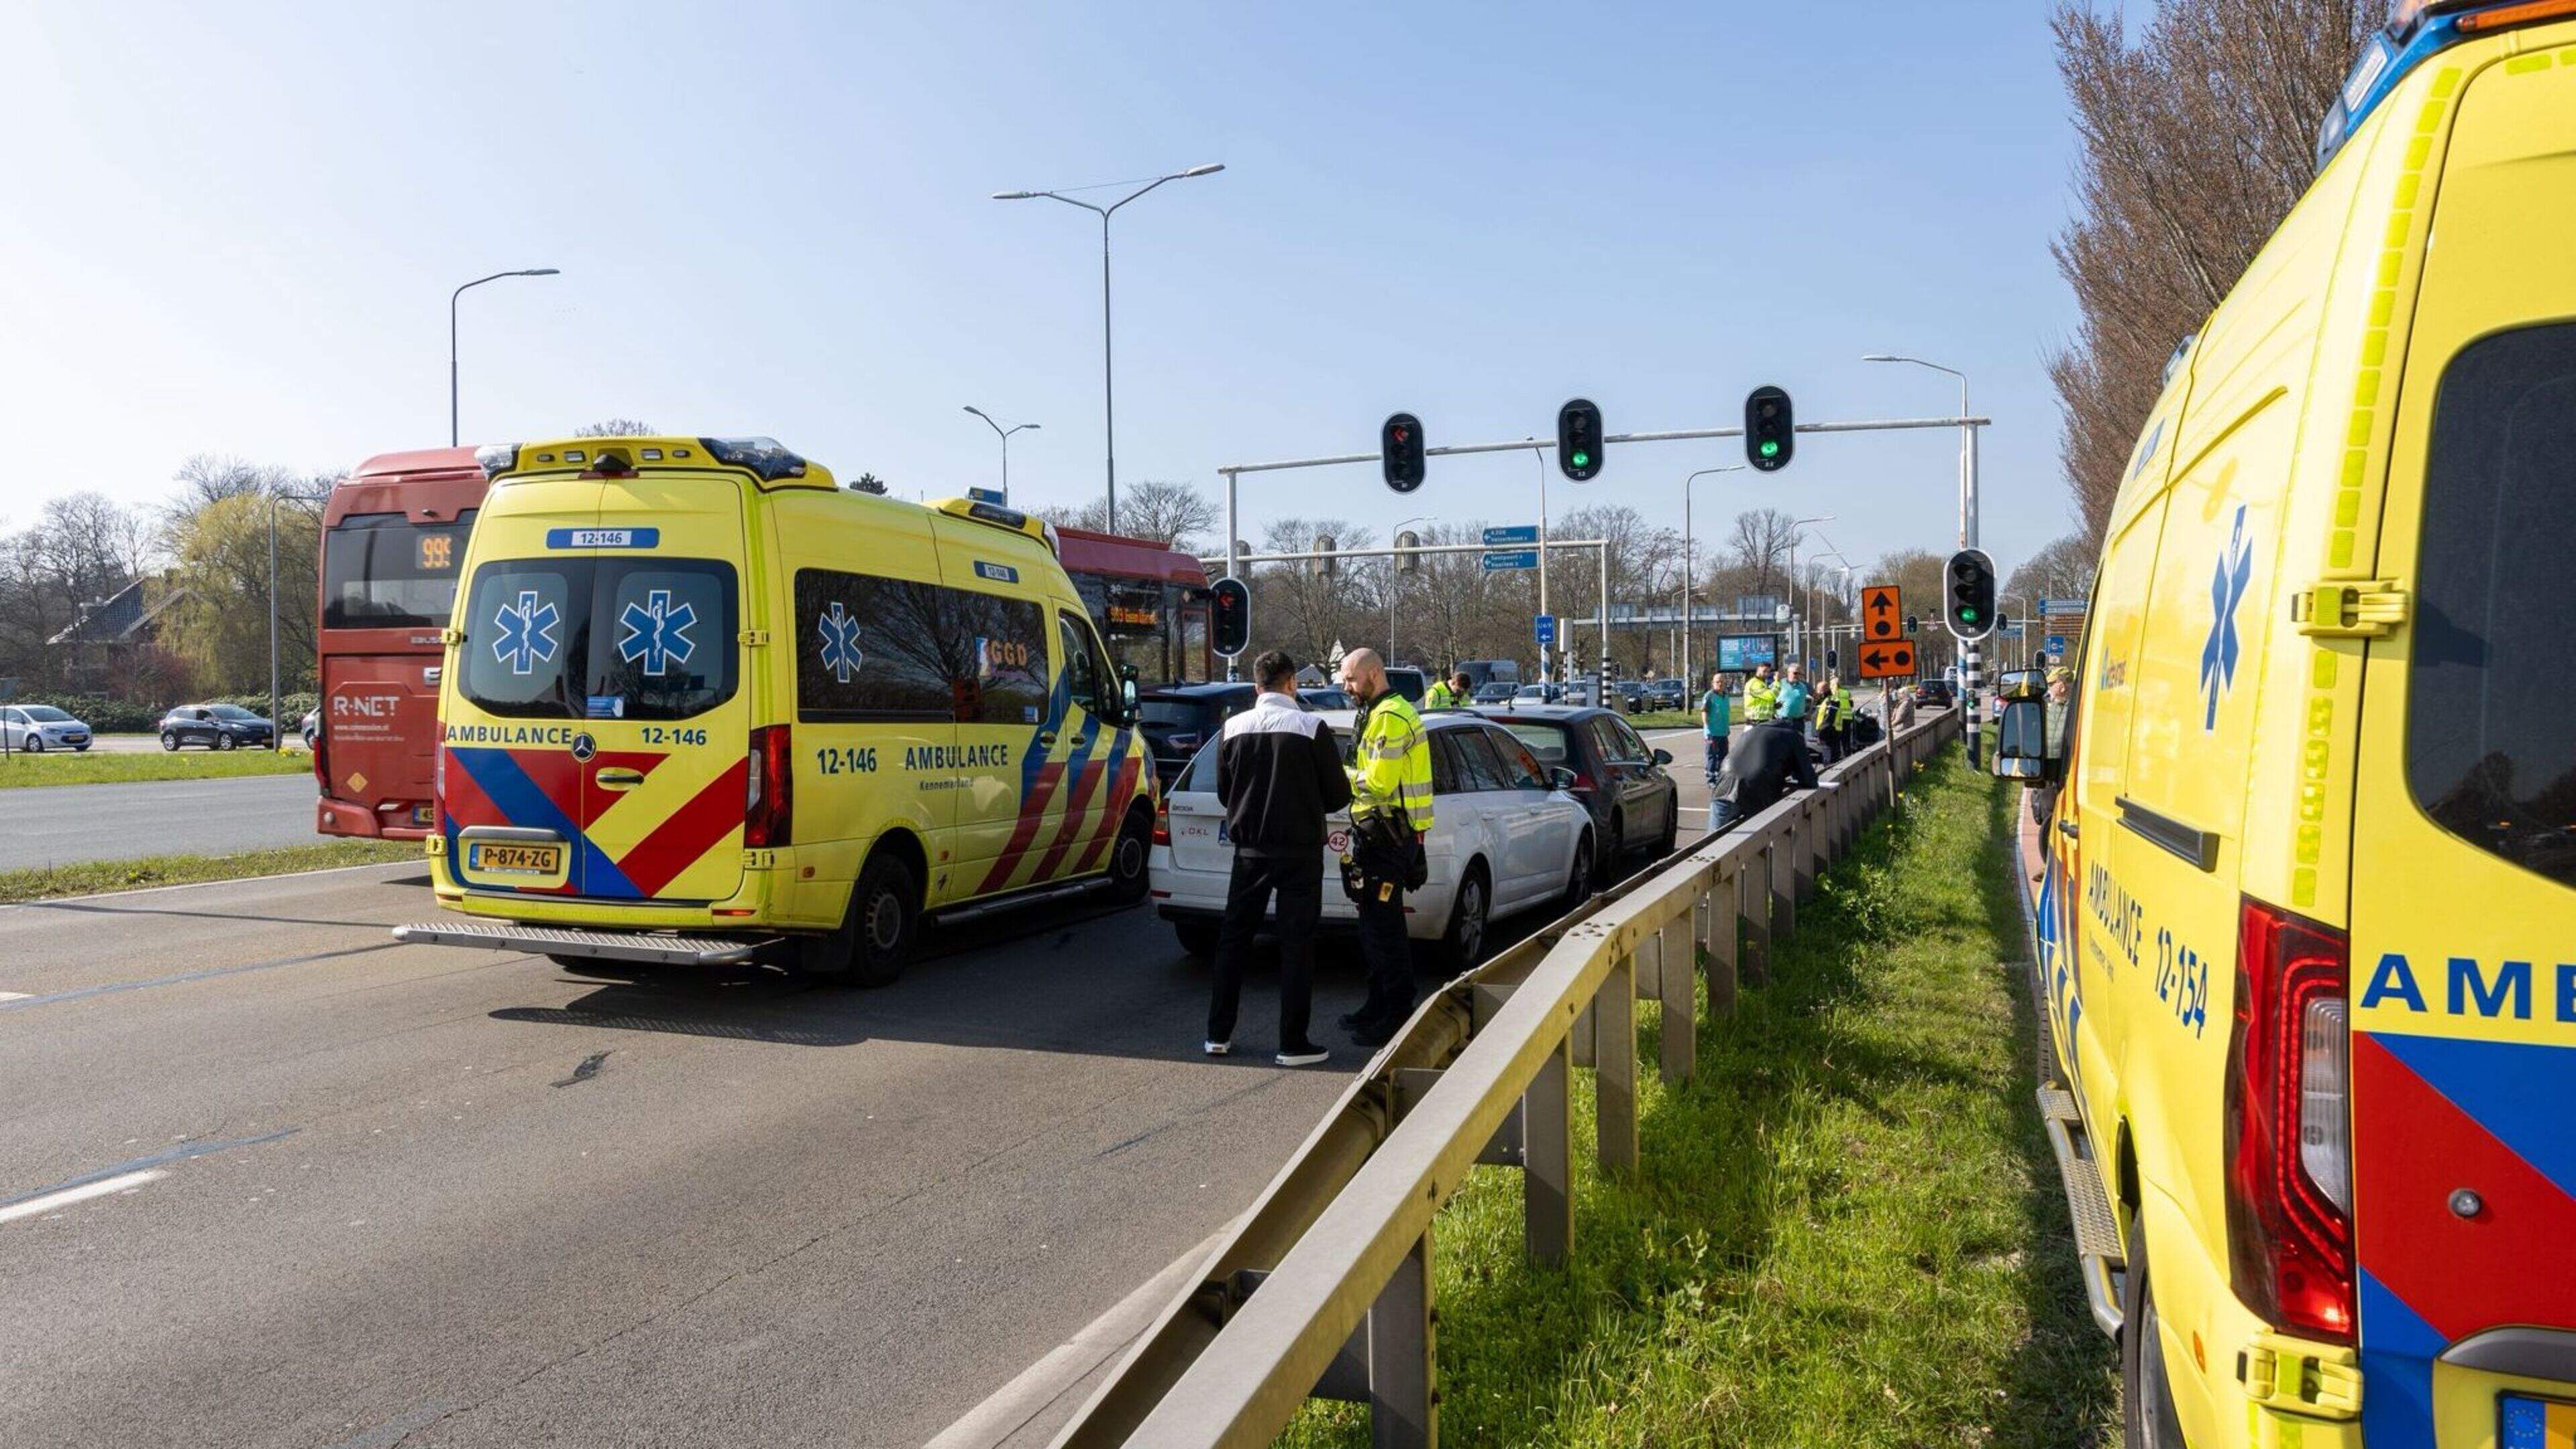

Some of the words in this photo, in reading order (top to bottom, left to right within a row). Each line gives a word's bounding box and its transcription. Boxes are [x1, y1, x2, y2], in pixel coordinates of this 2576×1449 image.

[581, 533, 623, 544] 12-146
[446, 725, 572, 744] AMBULANCE
[641, 728, 707, 745] 12-146
[816, 747, 877, 774] 12-146
[906, 745, 1008, 770] AMBULANCE
[1330, 837, 1346, 847] 42
[484, 847, 551, 867] P-874-ZG
[2088, 859, 2143, 967] AMBULANCE
[2155, 925, 2208, 1040] 12-154
